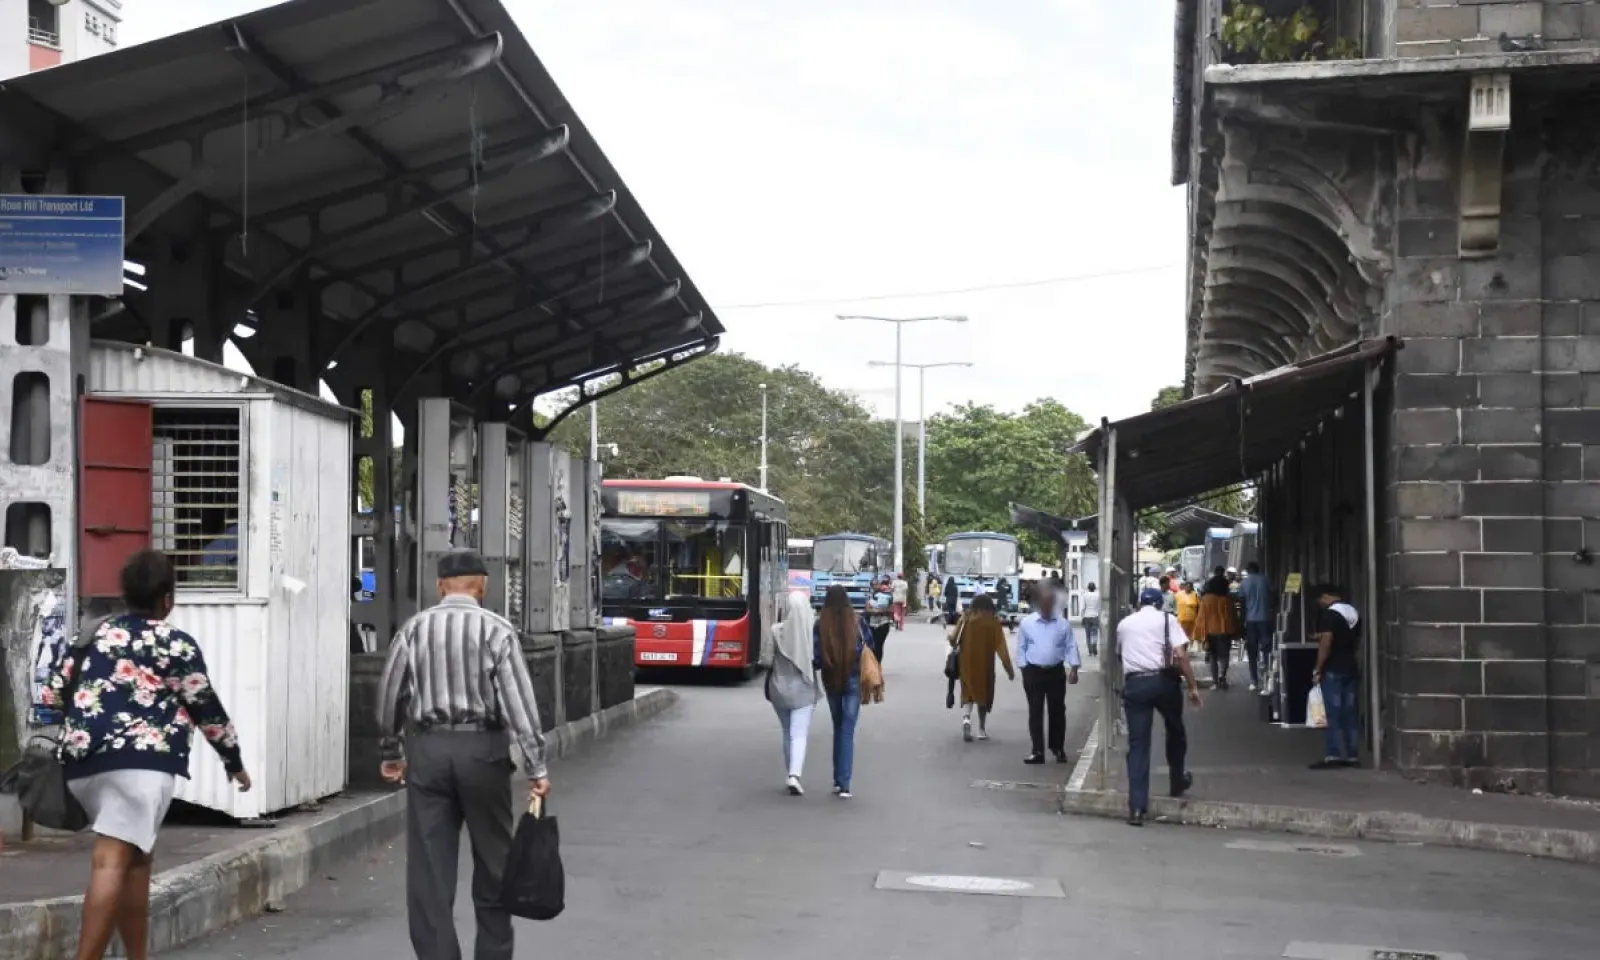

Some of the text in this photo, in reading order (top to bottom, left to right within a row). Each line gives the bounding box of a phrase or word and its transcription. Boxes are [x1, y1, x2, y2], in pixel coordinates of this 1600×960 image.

[24, 199, 37, 212] Hill
[39, 199, 78, 214] Transport
[80, 200, 94, 212] Ltd
